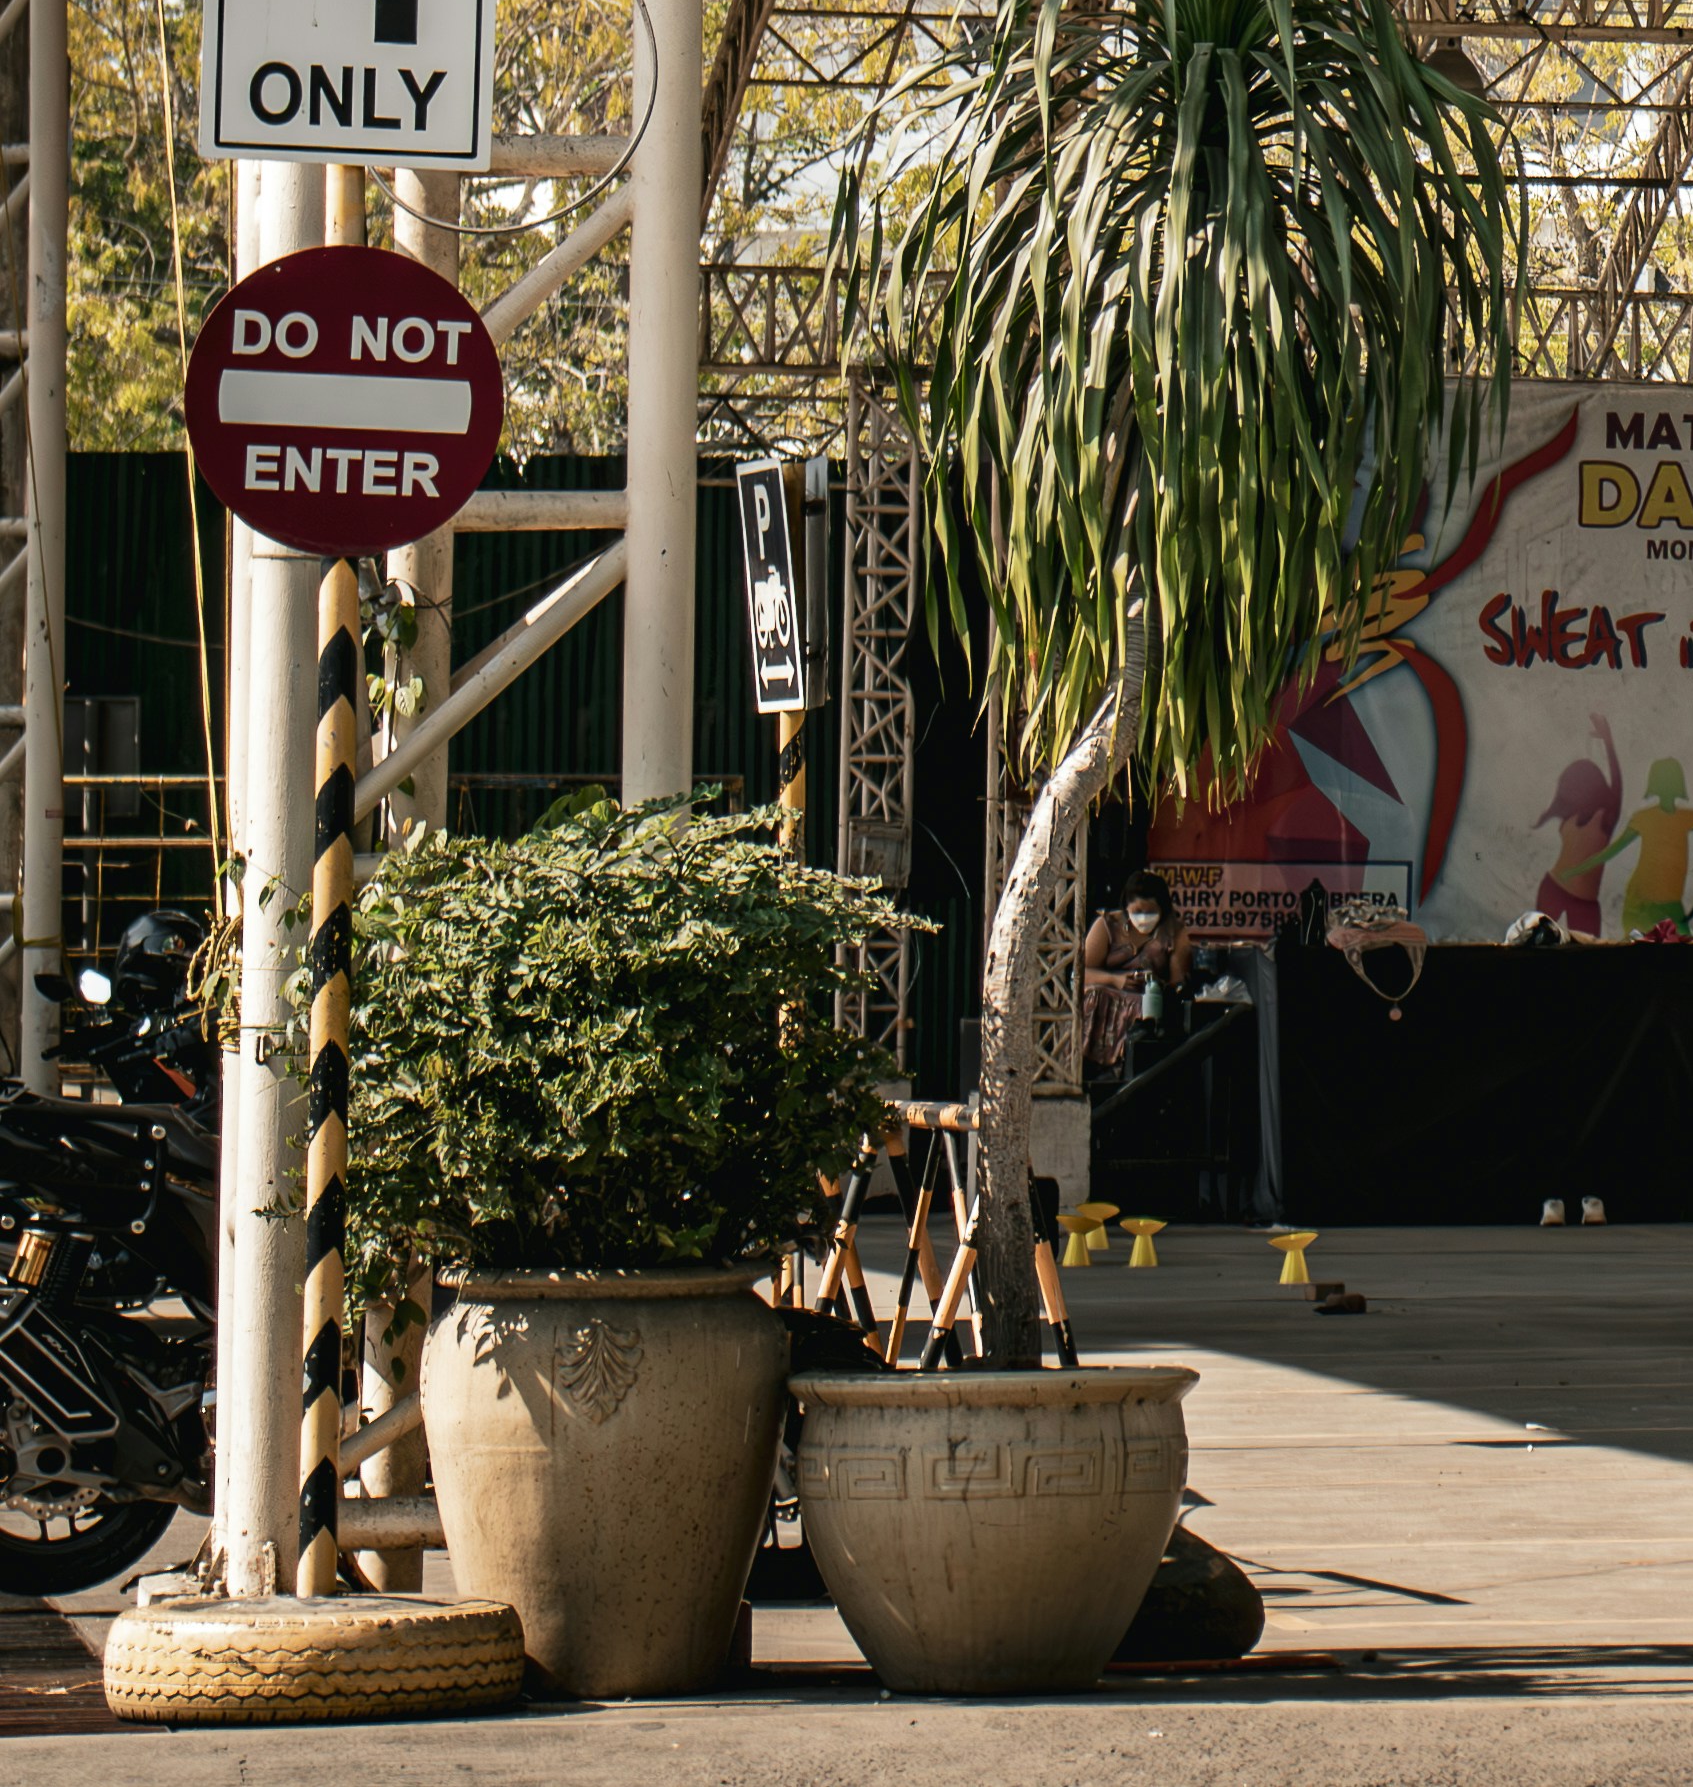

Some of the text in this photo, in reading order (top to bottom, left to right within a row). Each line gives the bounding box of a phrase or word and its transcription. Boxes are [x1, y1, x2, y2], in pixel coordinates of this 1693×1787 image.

[249, 61, 448, 132] ONLY
[231, 309, 472, 365] DO NOT
[244, 444, 440, 498] ENTER
[753, 483, 771, 561] P
[1478, 589, 1666, 670] SWEAT
[1170, 890, 1224, 908] AHRY
[1229, 890, 1297, 909] PORTO
